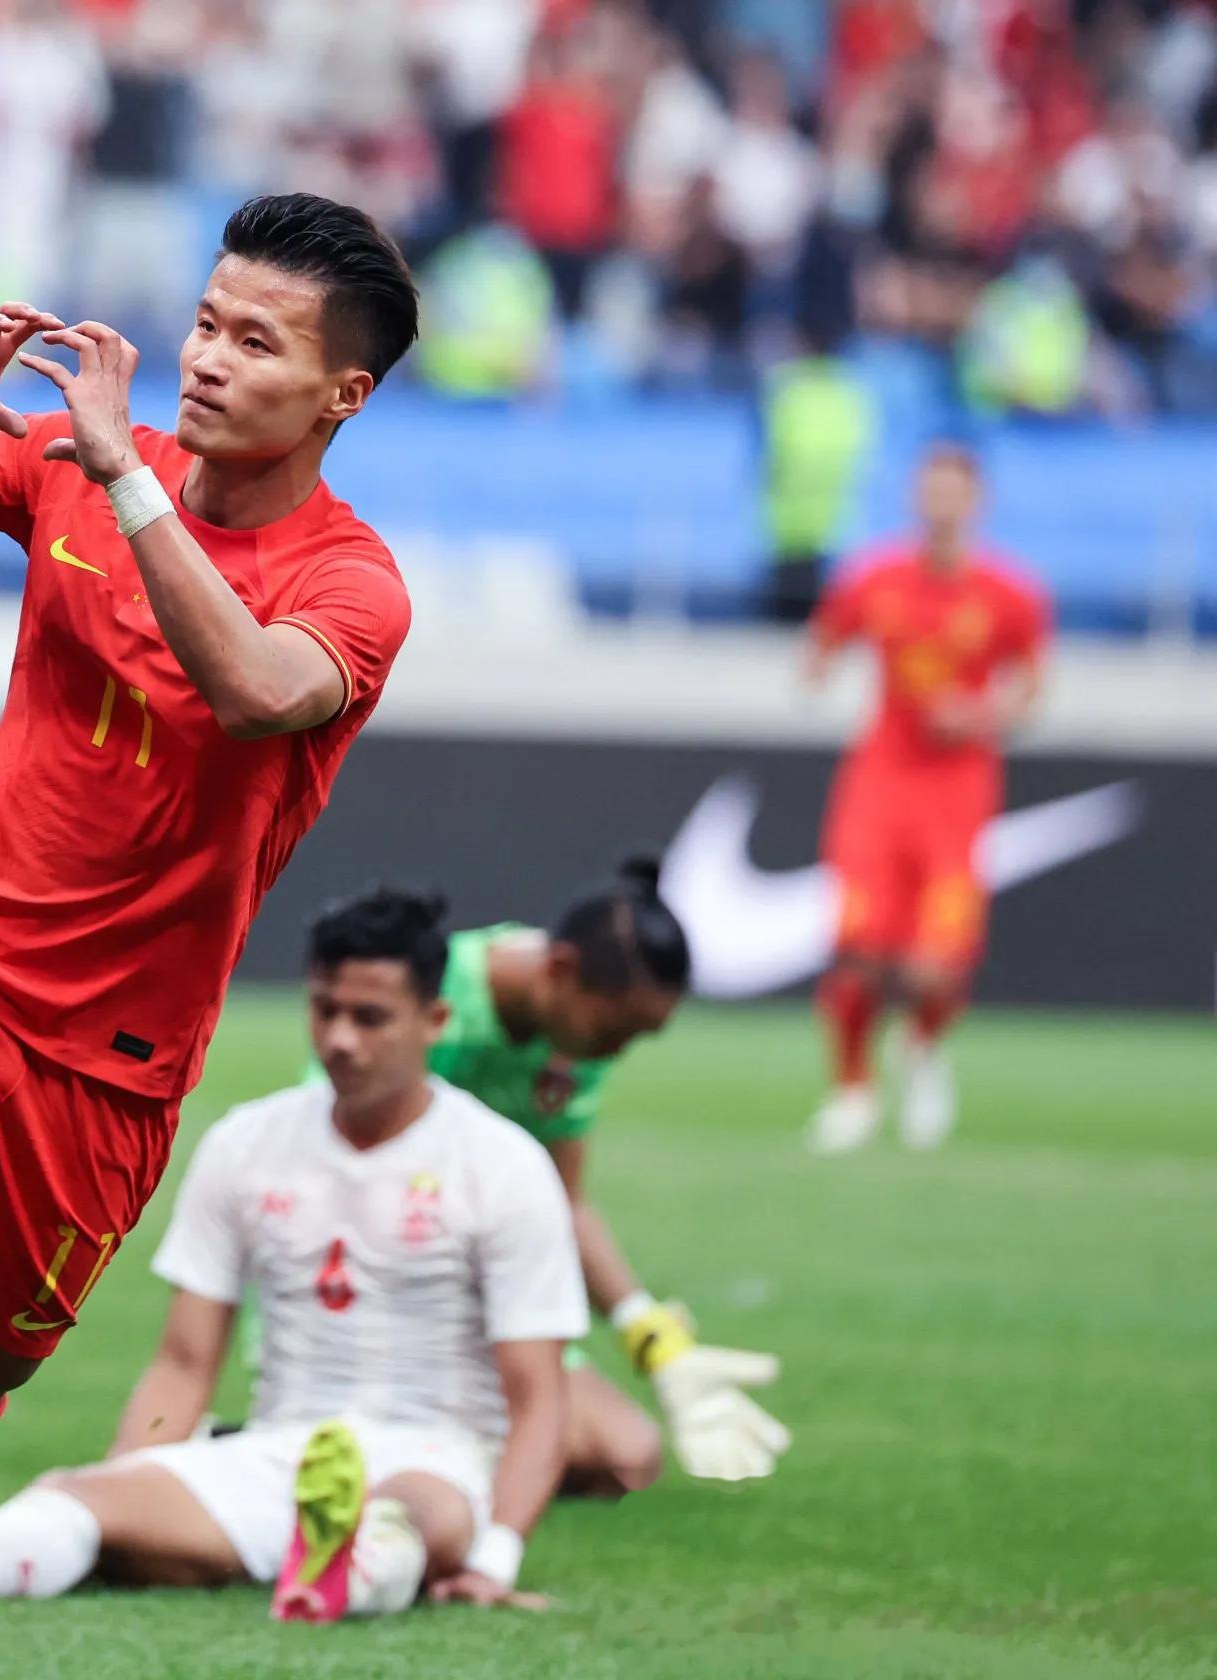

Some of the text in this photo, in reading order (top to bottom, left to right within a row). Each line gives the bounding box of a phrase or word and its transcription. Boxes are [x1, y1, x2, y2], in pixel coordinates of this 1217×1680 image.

[91, 674, 153, 768] 11
[36, 1223, 117, 1310] 11
[314, 1237, 357, 1313] 6
